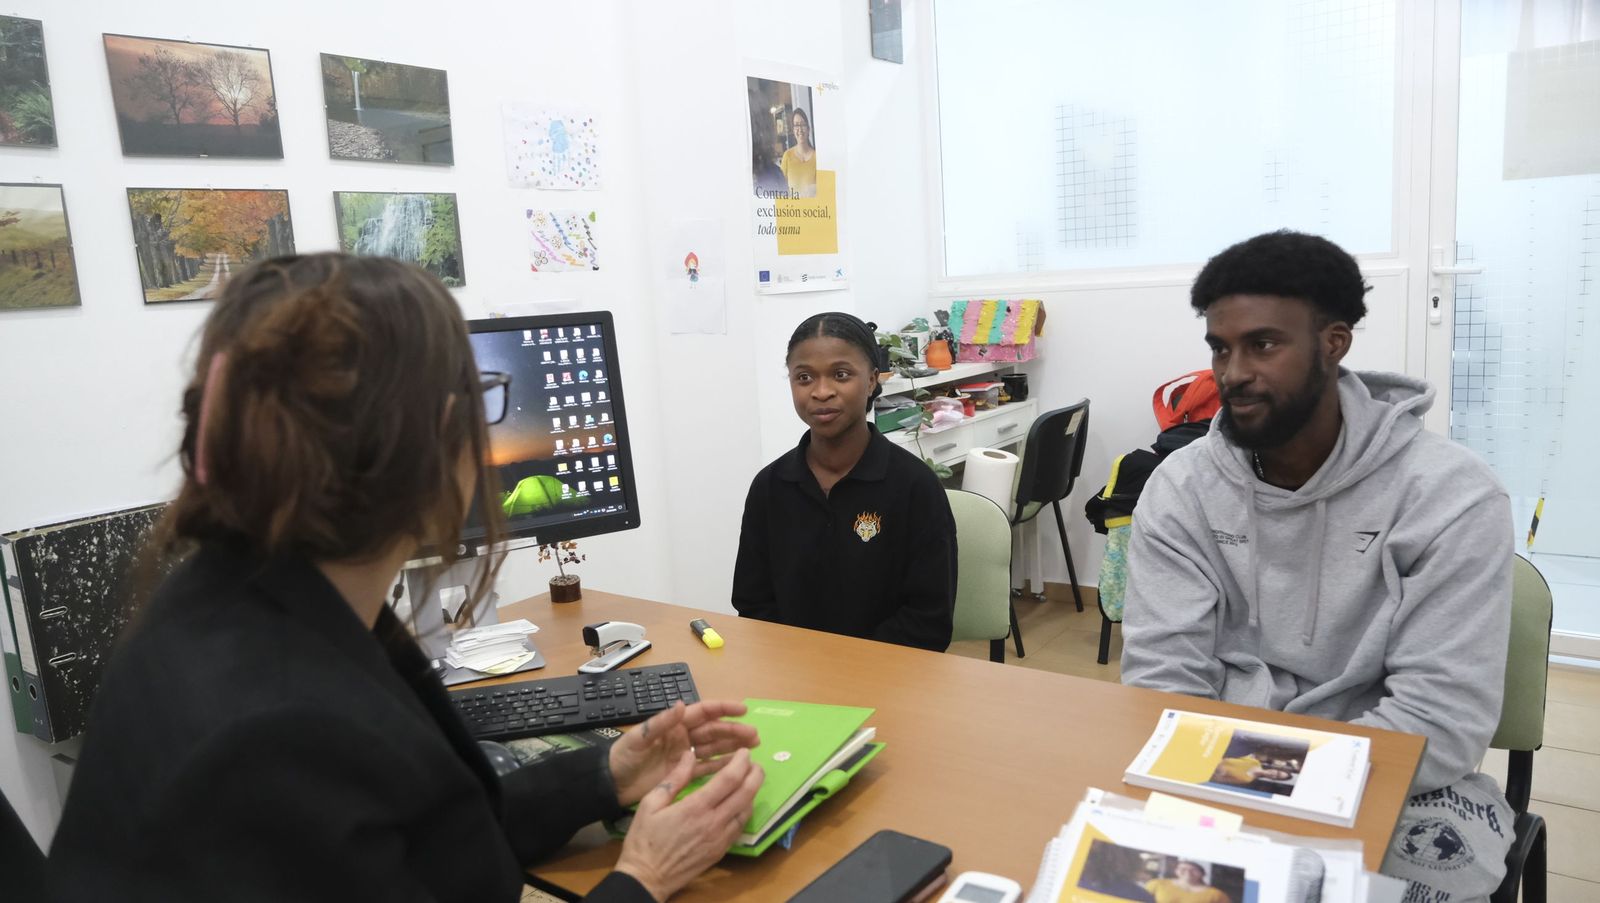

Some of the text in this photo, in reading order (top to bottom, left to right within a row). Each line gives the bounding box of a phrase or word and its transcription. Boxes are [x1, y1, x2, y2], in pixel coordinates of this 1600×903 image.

[755, 186, 800, 200] Contra la
[756, 205, 831, 219] exclusión social,
[757, 222, 801, 235] todo suma
